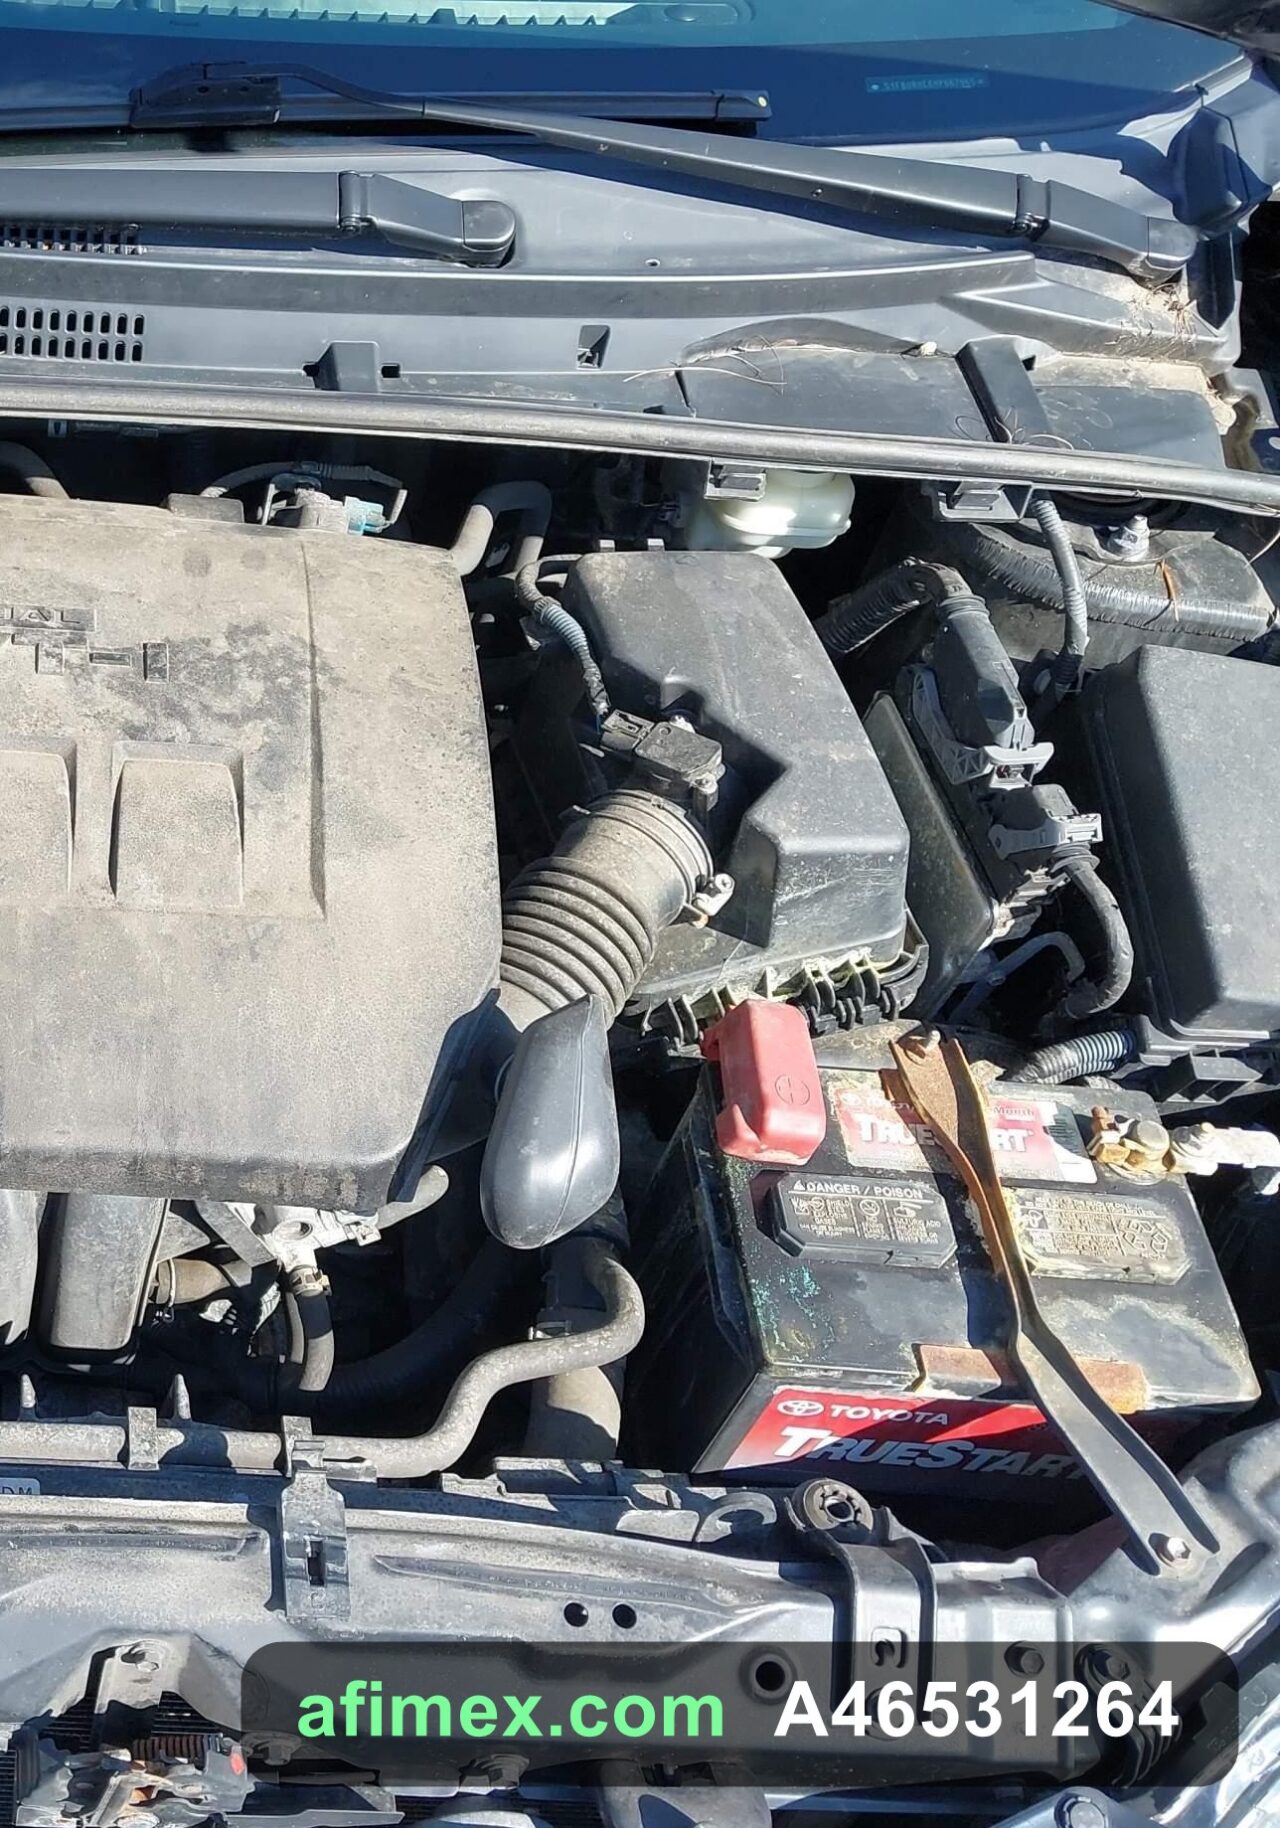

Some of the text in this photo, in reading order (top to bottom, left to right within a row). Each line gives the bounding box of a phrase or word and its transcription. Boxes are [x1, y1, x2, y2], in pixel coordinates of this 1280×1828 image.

[806, 1181, 861, 1196] DANGER
[874, 1186, 924, 1199] POISON
[830, 1404, 948, 1425] TOYOTA
